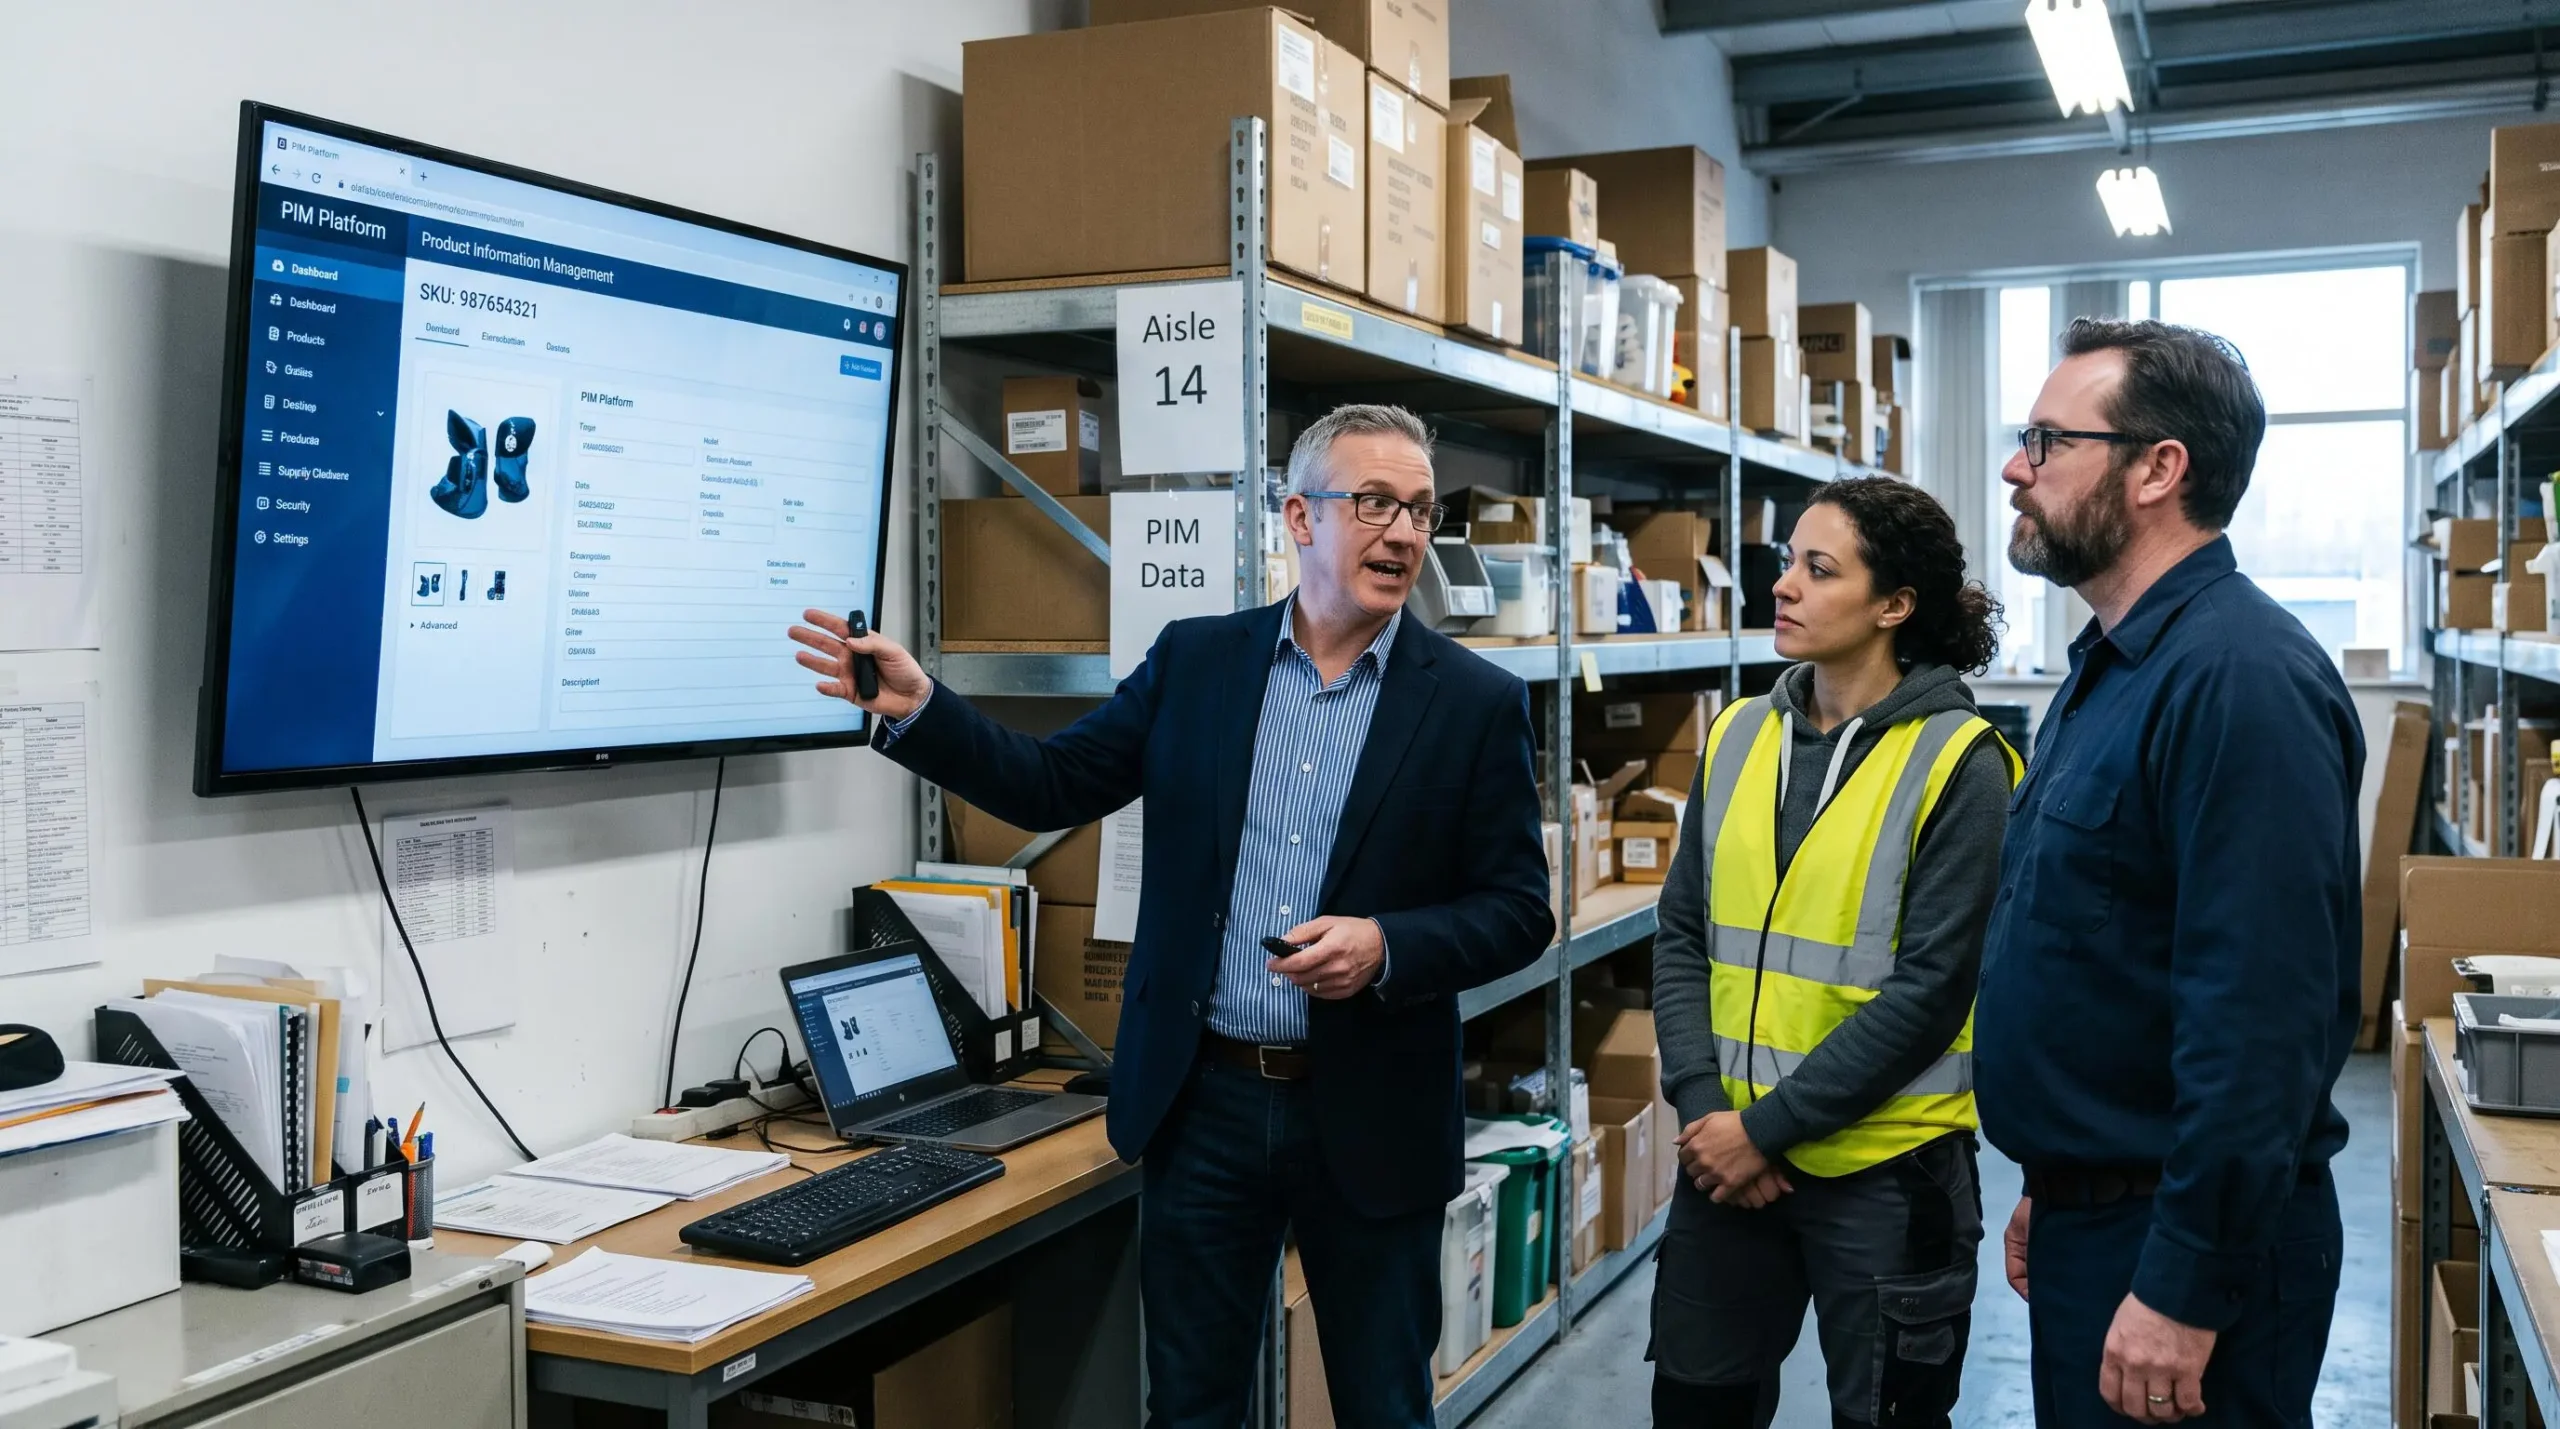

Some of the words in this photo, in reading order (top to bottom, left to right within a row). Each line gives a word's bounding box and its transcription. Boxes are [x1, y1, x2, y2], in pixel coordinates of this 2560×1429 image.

[291, 141, 306, 152] PIM
[307, 145, 340, 160] Platform
[281, 200, 314, 226] PIM
[318, 208, 387, 240] Platform
[421, 231, 470, 256] Product
[473, 242, 541, 270] Information
[543, 256, 615, 285] Management
[291, 263, 338, 281] Dashboard
[290, 297, 337, 314] Dashboard
[420, 282, 456, 306] SKU:
[459, 289, 538, 320] 987654321
[1143, 311, 1215, 343] Aisle
[286, 331, 326, 346] Products
[1155, 364, 1208, 407] 14
[580, 391, 598, 403] PIM
[599, 393, 634, 408] Platform
[275, 499, 311, 513] Security
[273, 532, 309, 547] Settings
[1147, 519, 1200, 545] PIM
[1141, 562, 1206, 588] Data
[420, 621, 458, 630] Advanced
